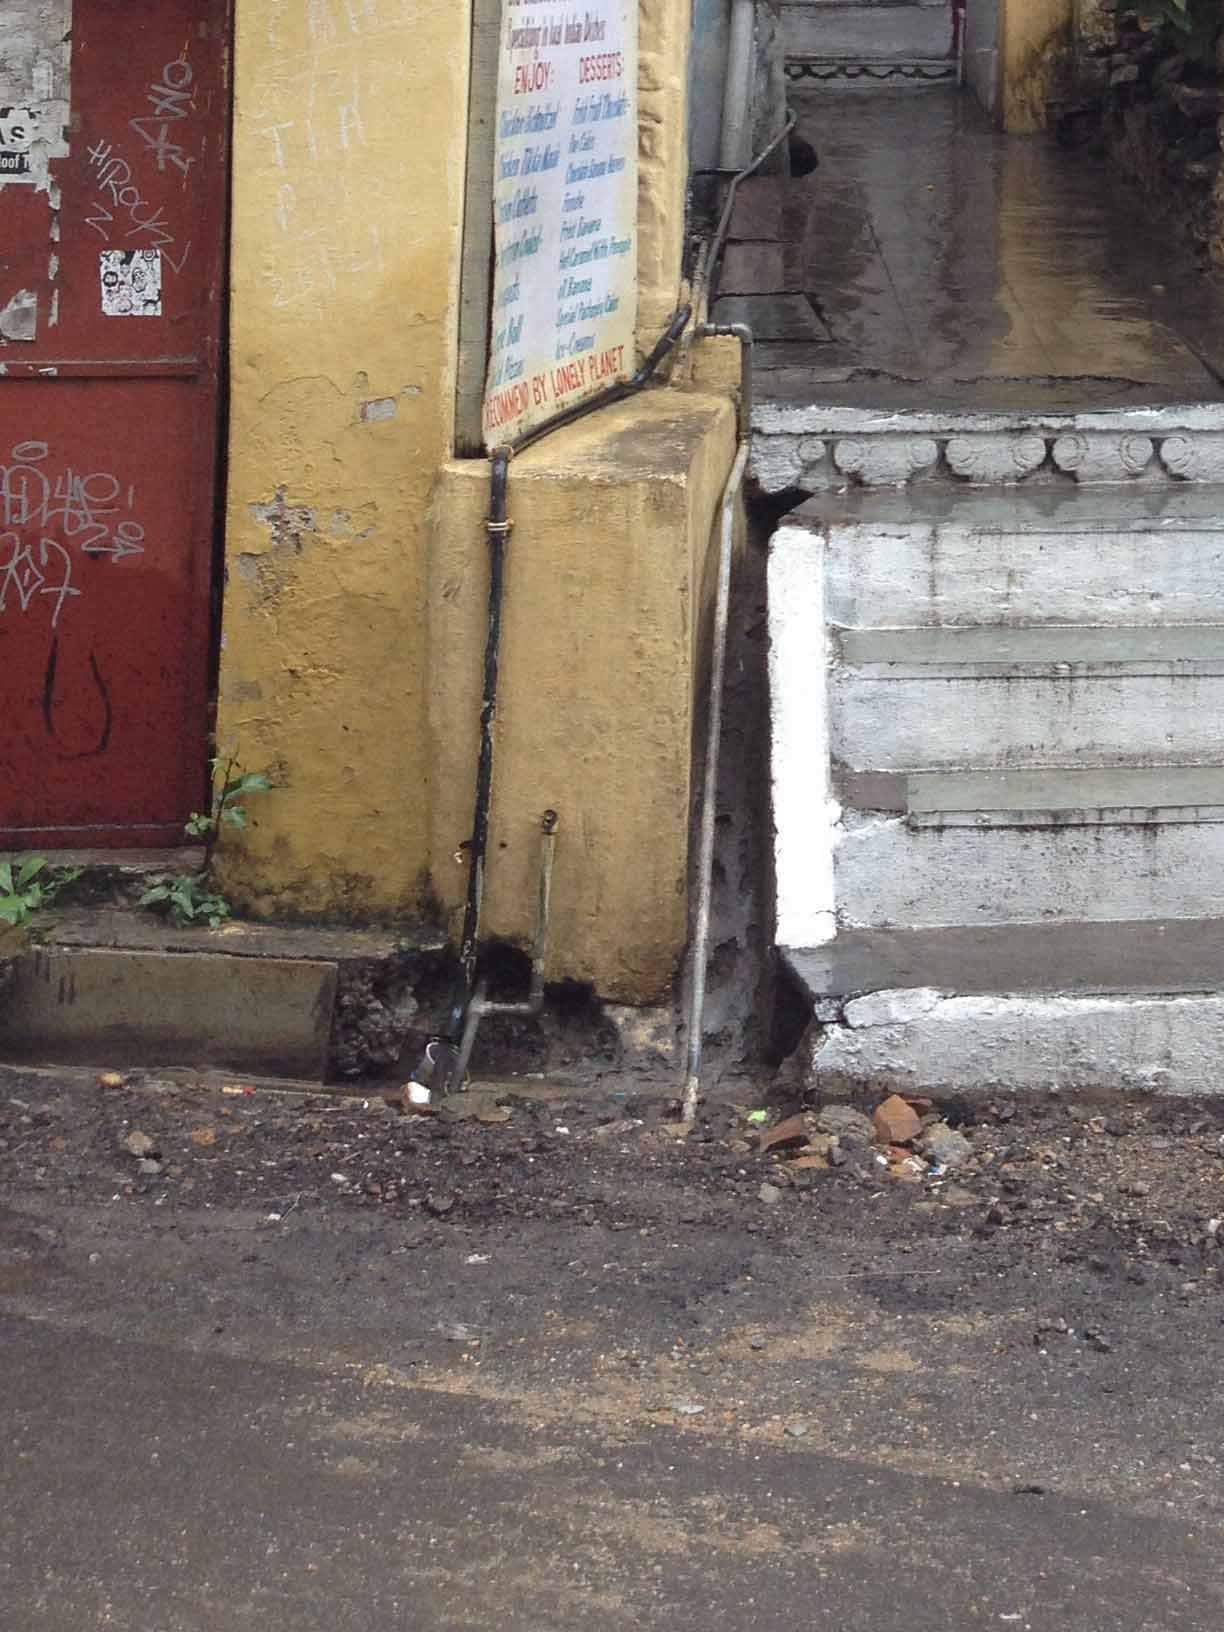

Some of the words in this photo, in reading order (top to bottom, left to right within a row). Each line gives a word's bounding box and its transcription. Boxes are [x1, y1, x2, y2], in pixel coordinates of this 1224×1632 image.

[533, 373, 547, 406] BY
[551, 357, 586, 399] LONELY
[588, 344, 625, 380] PLANET
